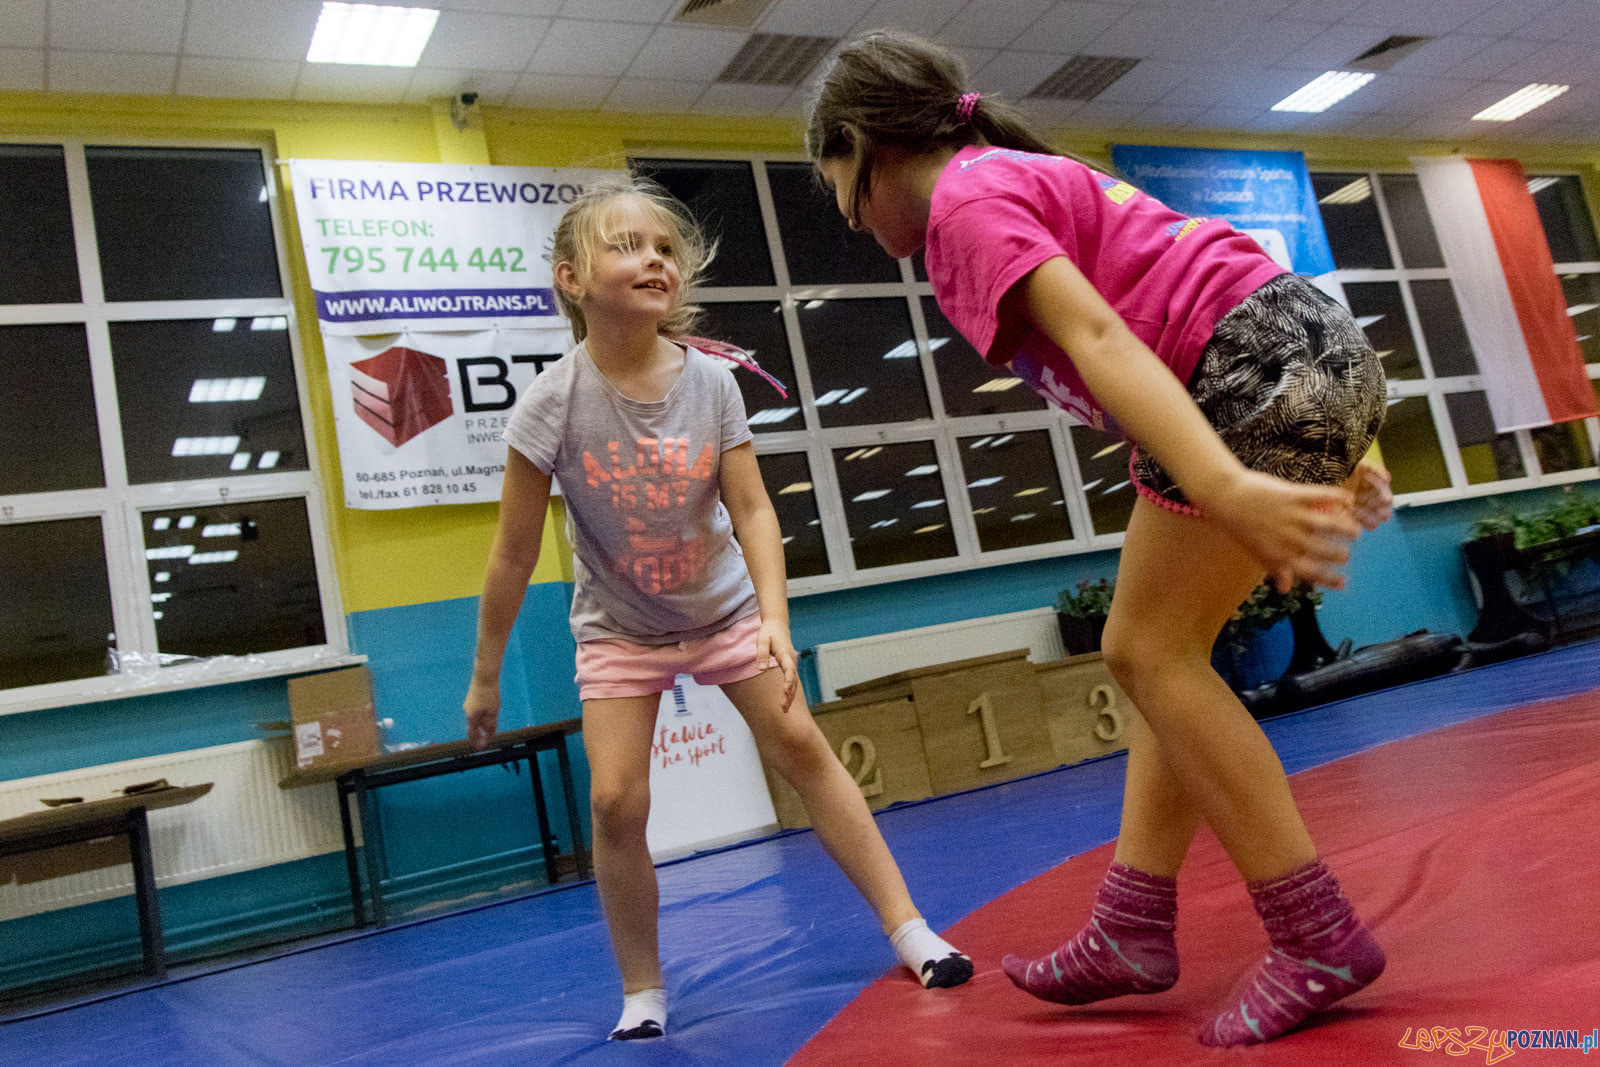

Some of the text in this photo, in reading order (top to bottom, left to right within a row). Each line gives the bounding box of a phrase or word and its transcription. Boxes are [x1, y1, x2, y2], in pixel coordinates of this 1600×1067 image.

[311, 177, 409, 200] FIRMA
[317, 218, 434, 237] TELEFON:
[321, 247, 527, 274] 795 744 442
[325, 295, 548, 316] WWW.ALIWOJTRANS.PL
[404, 486, 417, 497] 61
[446, 483, 460, 494] 10
[463, 482, 477, 492] 45
[841, 685, 1123, 799] 2 1 3
